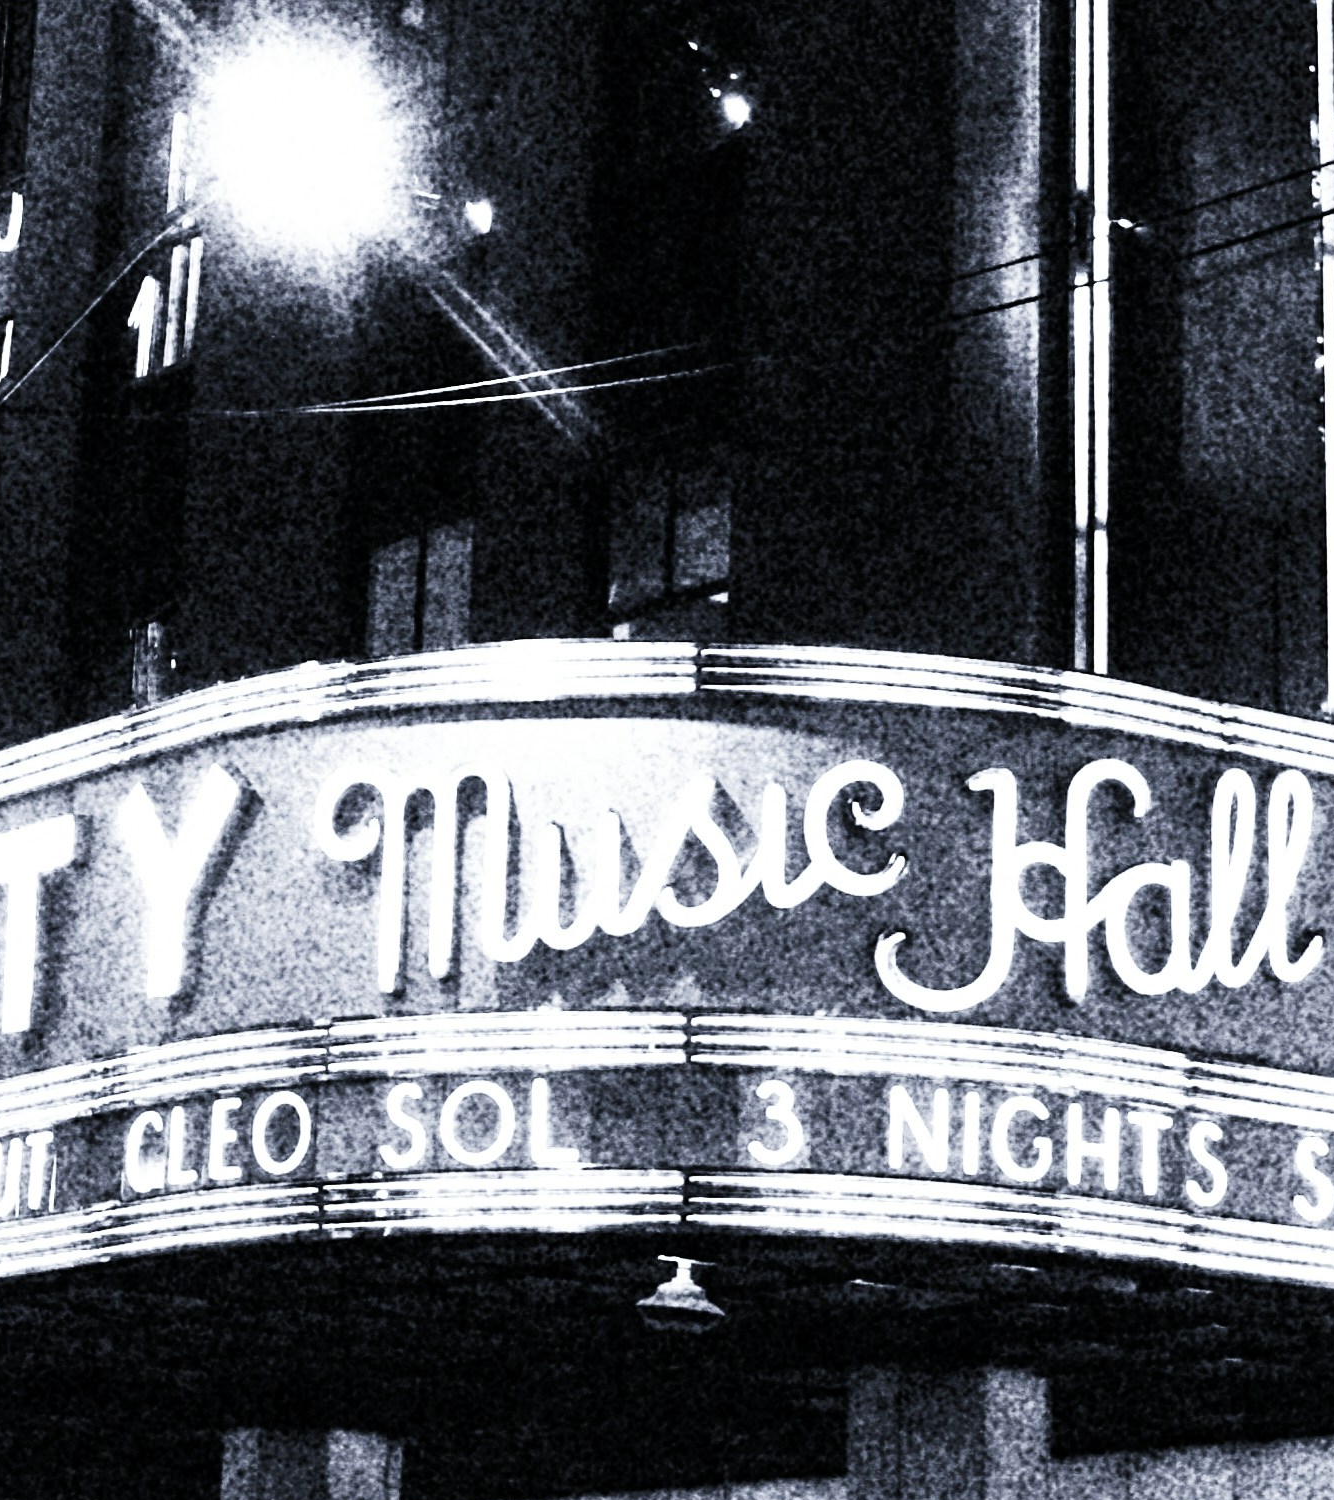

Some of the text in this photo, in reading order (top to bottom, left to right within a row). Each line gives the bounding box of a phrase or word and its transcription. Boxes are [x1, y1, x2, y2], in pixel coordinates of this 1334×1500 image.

[314, 761, 907, 994] Music
[874, 758, 1323, 1012] Hall
[124, 1090, 312, 1193] CLEO
[379, 1078, 579, 1169] SOL
[747, 1080, 805, 1167] 3
[887, 1085, 1230, 1208] NIGHTS
